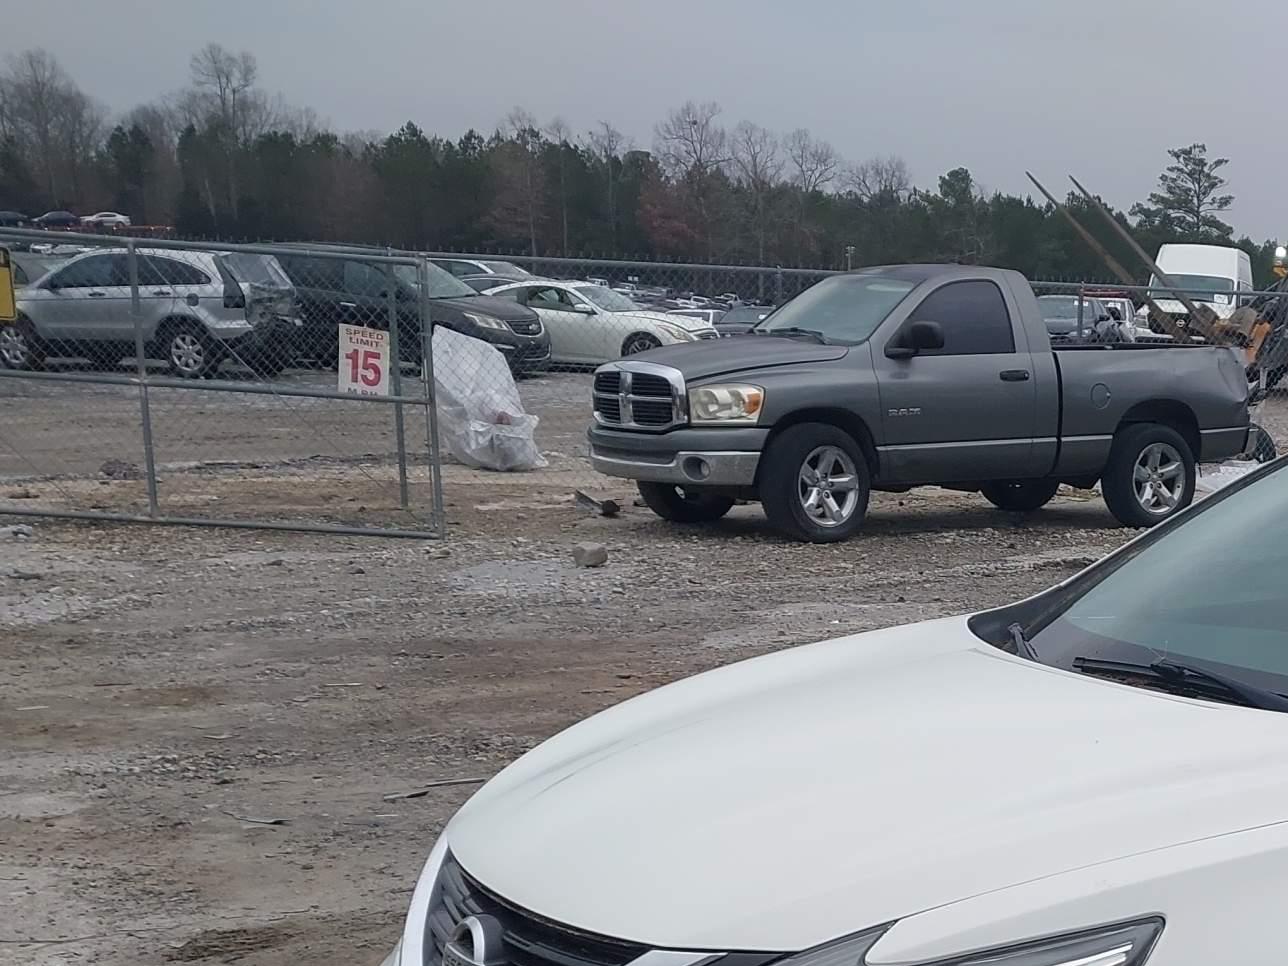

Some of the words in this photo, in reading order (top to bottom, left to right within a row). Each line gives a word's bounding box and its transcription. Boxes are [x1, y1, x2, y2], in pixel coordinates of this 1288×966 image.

[345, 328, 384, 340] SPEED
[349, 337, 380, 347] LIMIT
[345, 349, 381, 386] 15
